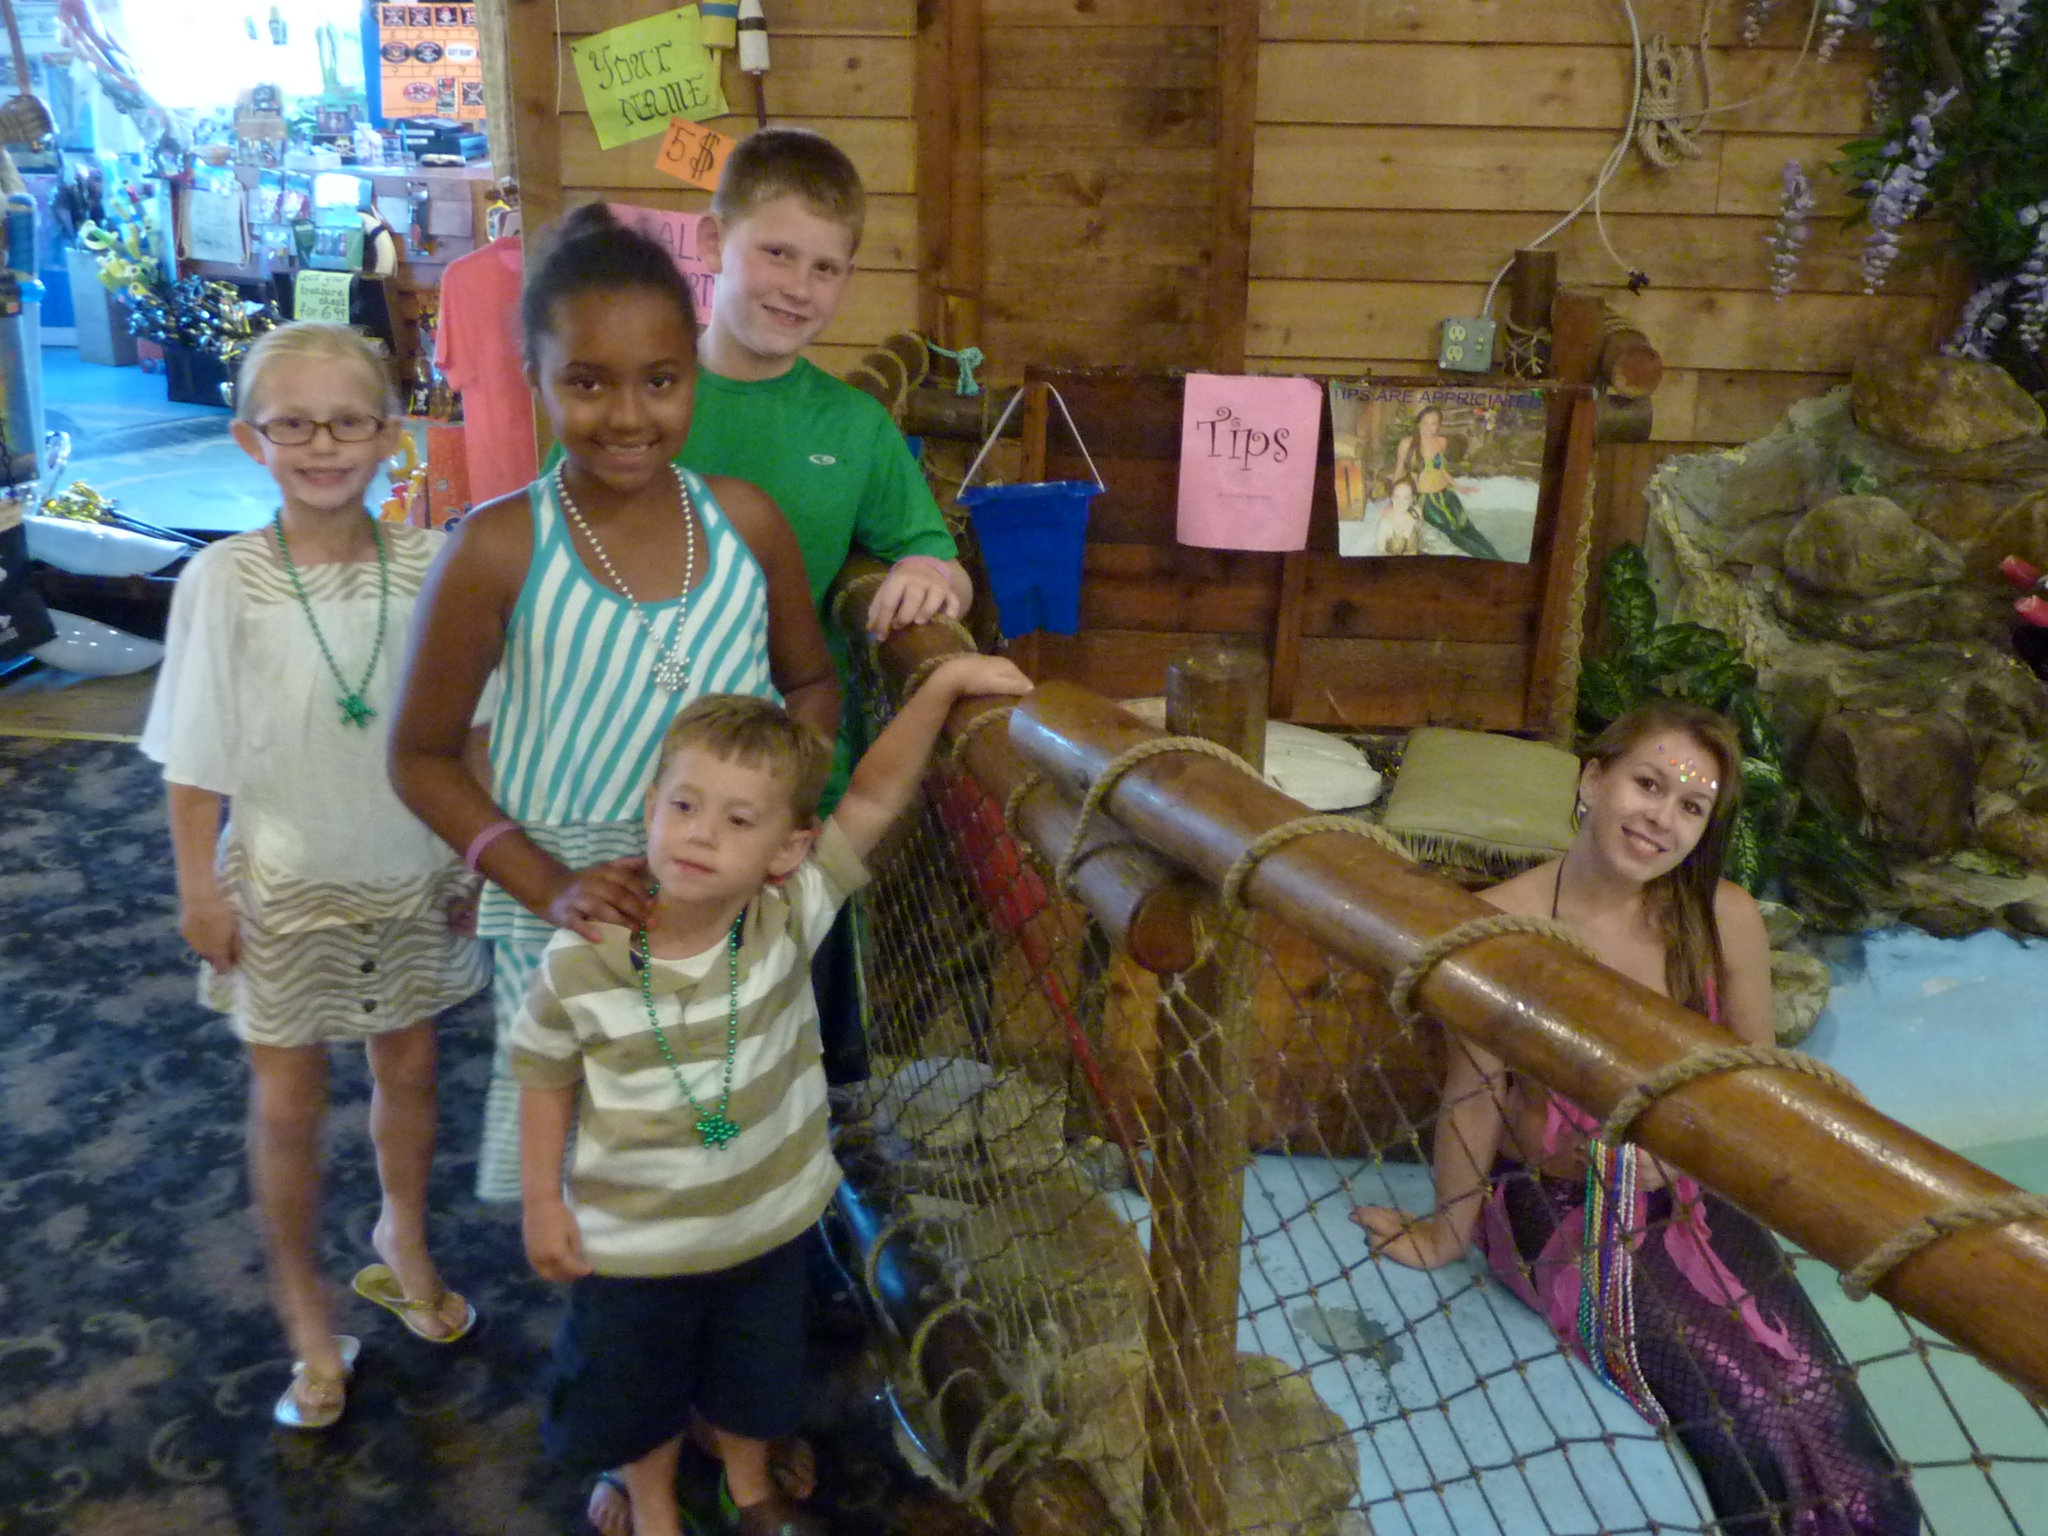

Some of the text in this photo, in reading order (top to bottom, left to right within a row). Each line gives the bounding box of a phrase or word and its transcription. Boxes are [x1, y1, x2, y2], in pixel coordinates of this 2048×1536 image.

[588, 39, 673, 90] Your
[299, 301, 318, 318] for
[1333, 387, 1371, 402] TIPS
[1375, 389, 1414, 404] ARE
[1196, 406, 1291, 471] Tips
